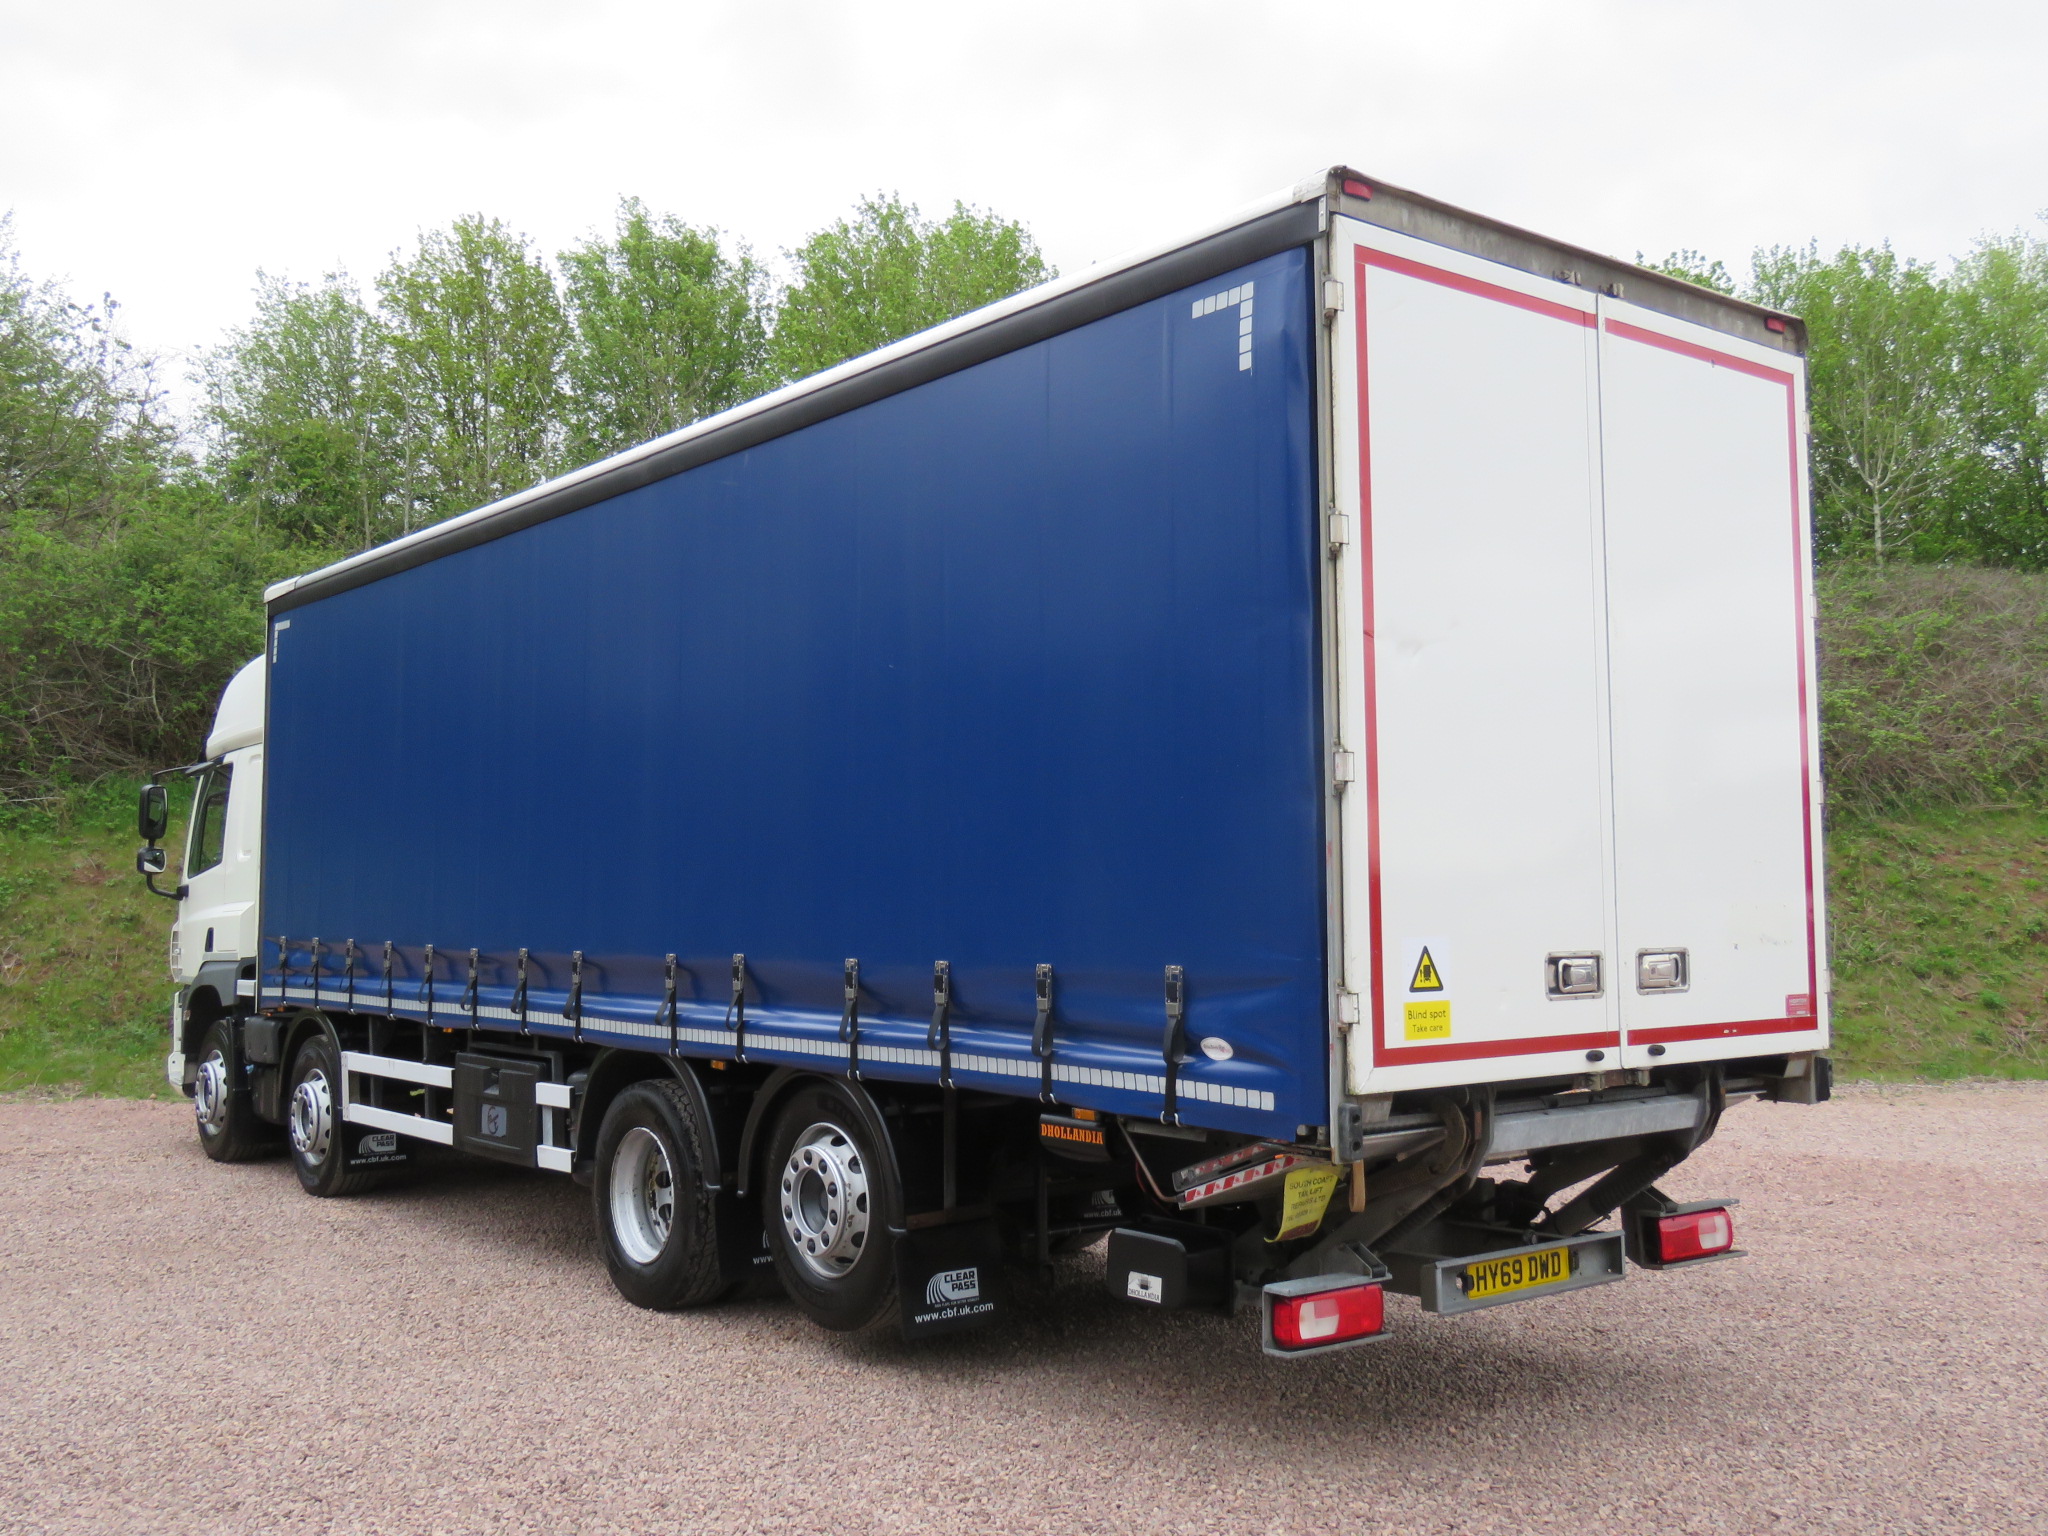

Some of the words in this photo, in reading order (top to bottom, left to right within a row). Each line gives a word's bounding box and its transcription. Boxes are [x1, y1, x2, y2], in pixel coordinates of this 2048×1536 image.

[1407, 1010, 1427, 1020] Blind
[1429, 1010, 1447, 1021] spot
[1412, 1024, 1428, 1033] Take
[1429, 1024, 1443, 1032] care
[371, 1134, 395, 1142] CLEAR
[1040, 1123, 1104, 1145] DHOLLANDIA
[350, 1154, 407, 1165] www.cbf.uk.com
[1309, 1186, 1324, 1195] LIFT
[944, 1270, 975, 1283] CLEAR
[1475, 1258, 1523, 1292] HY69
[1527, 1251, 1561, 1282] DWD
[951, 1280, 976, 1292] PASS
[1128, 1287, 1160, 1302] DHOLLANDIA
[914, 1302, 994, 1323] www.cbf.uk.com
